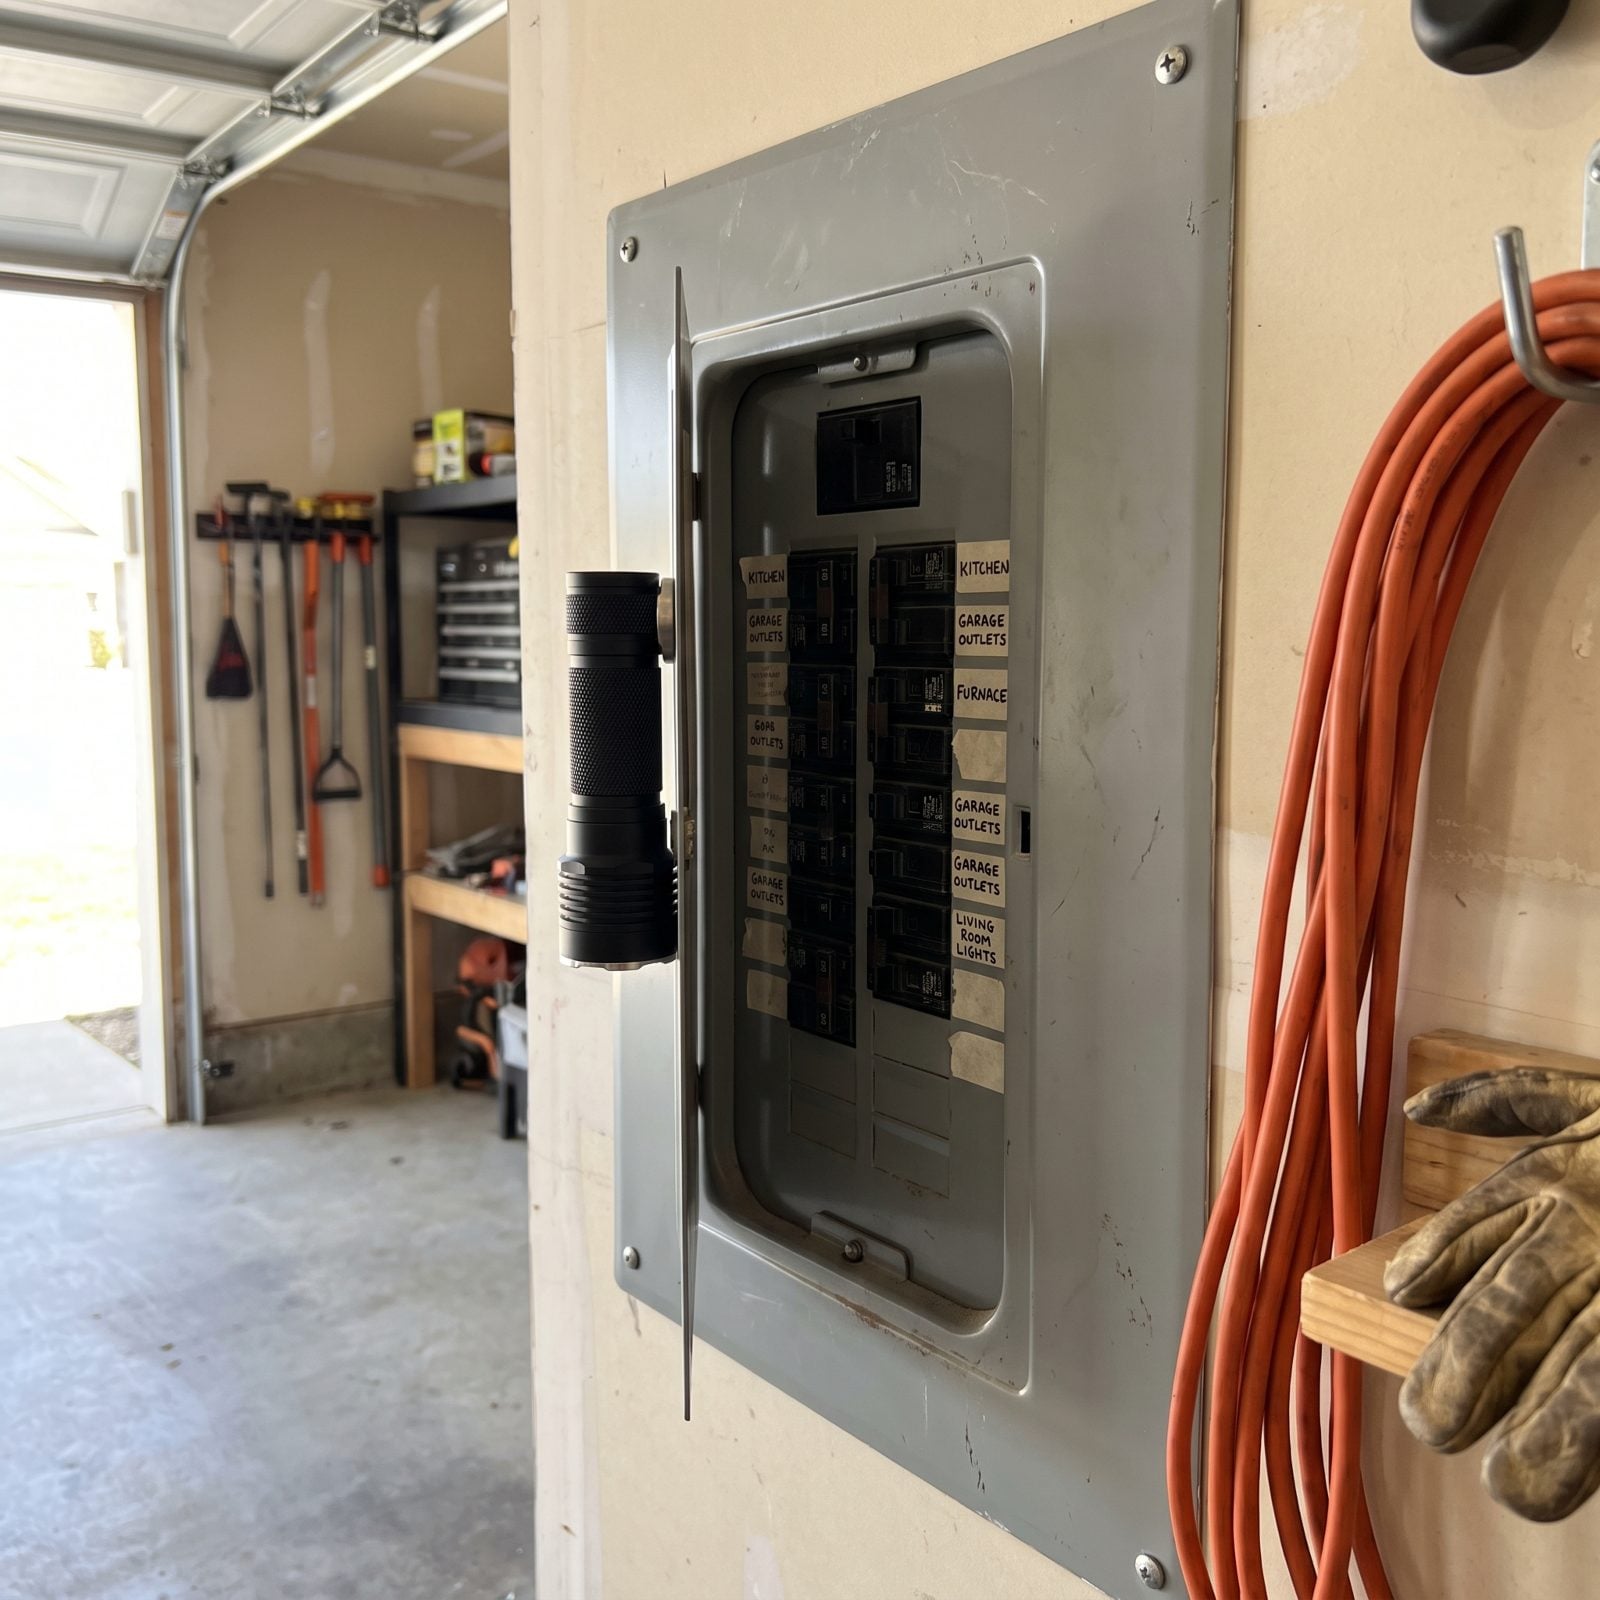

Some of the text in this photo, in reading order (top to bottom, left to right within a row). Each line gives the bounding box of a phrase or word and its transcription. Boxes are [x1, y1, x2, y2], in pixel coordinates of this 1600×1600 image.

[748, 569, 785, 585] KITCHEN
[960, 559, 1009, 577] KITCHEN
[749, 614, 783, 628] GARAGE
[958, 613, 1005, 628] GARAGE
[749, 631, 783, 643] OUTLETS
[958, 633, 1007, 646] OUTLETS
[956, 684, 1007, 703] FURNACE
[750, 736, 784, 750] OUTLETS
[954, 797, 1000, 816] GARAGE
[954, 817, 1001, 835] OUTLETS
[954, 856, 999, 877] GARAGE
[751, 872, 783, 890] GARAGE
[953, 876, 1000, 896] OUTLETS
[751, 889, 784, 906] OUTLETS
[956, 912, 995, 933] LIVING
[960, 928, 991, 947] ROOM
[956, 943, 997, 964] LIGHTS
